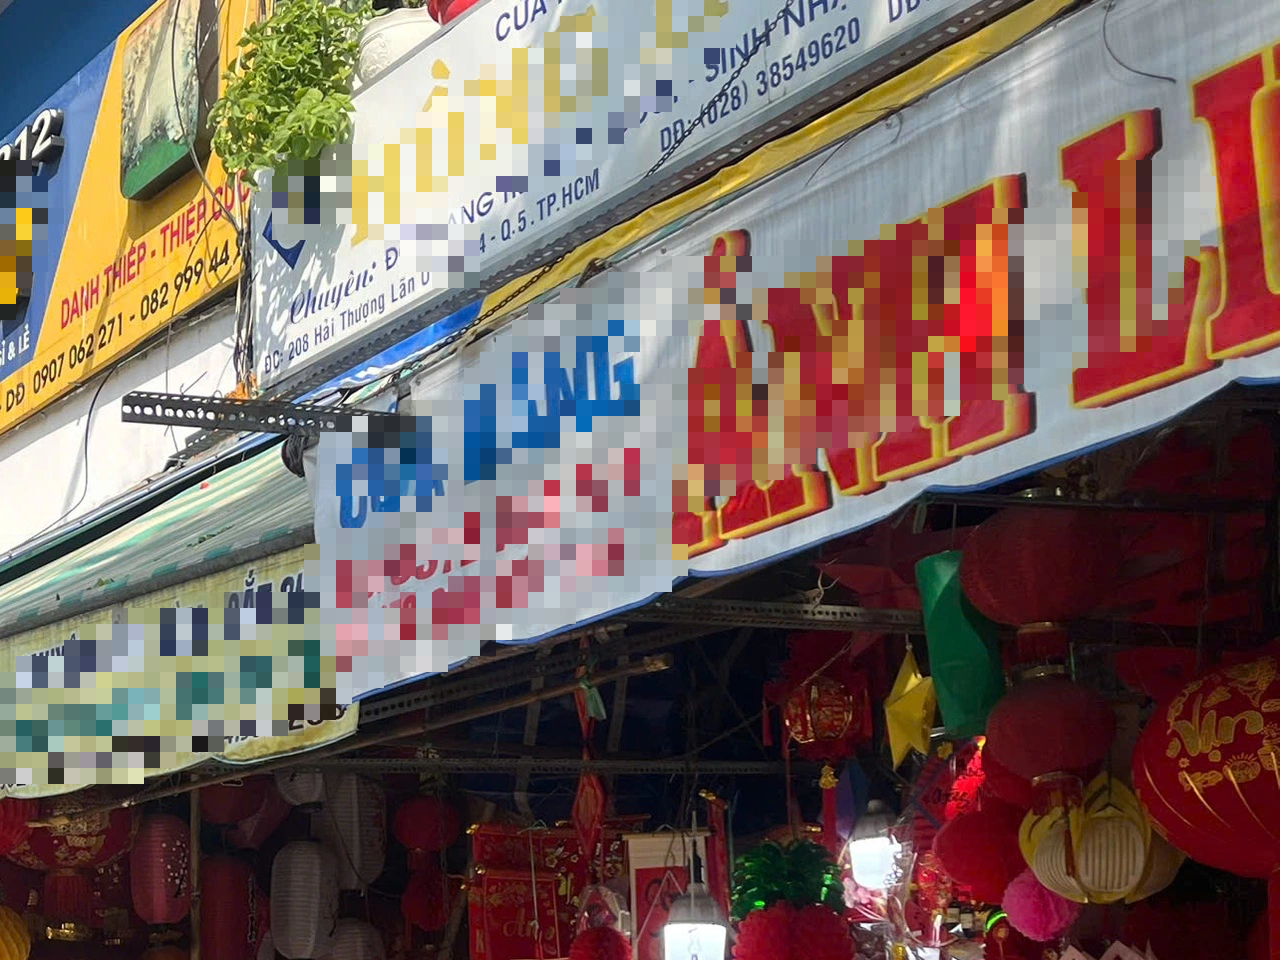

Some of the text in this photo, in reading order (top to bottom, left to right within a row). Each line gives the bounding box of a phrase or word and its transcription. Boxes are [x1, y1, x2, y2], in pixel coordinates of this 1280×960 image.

[756, 17, 861, 98] 38549620
[33, 350, 66, 396] 0907
[70, 334, 95, 368] 062
[98, 312, 124, 351] 271
[140, 282, 169, 320] 082
[174, 259, 203, 296] 999
[61, 278, 100, 330] DANH
[288, 332, 309, 361] 208
[314, 316, 335, 349] Hải
